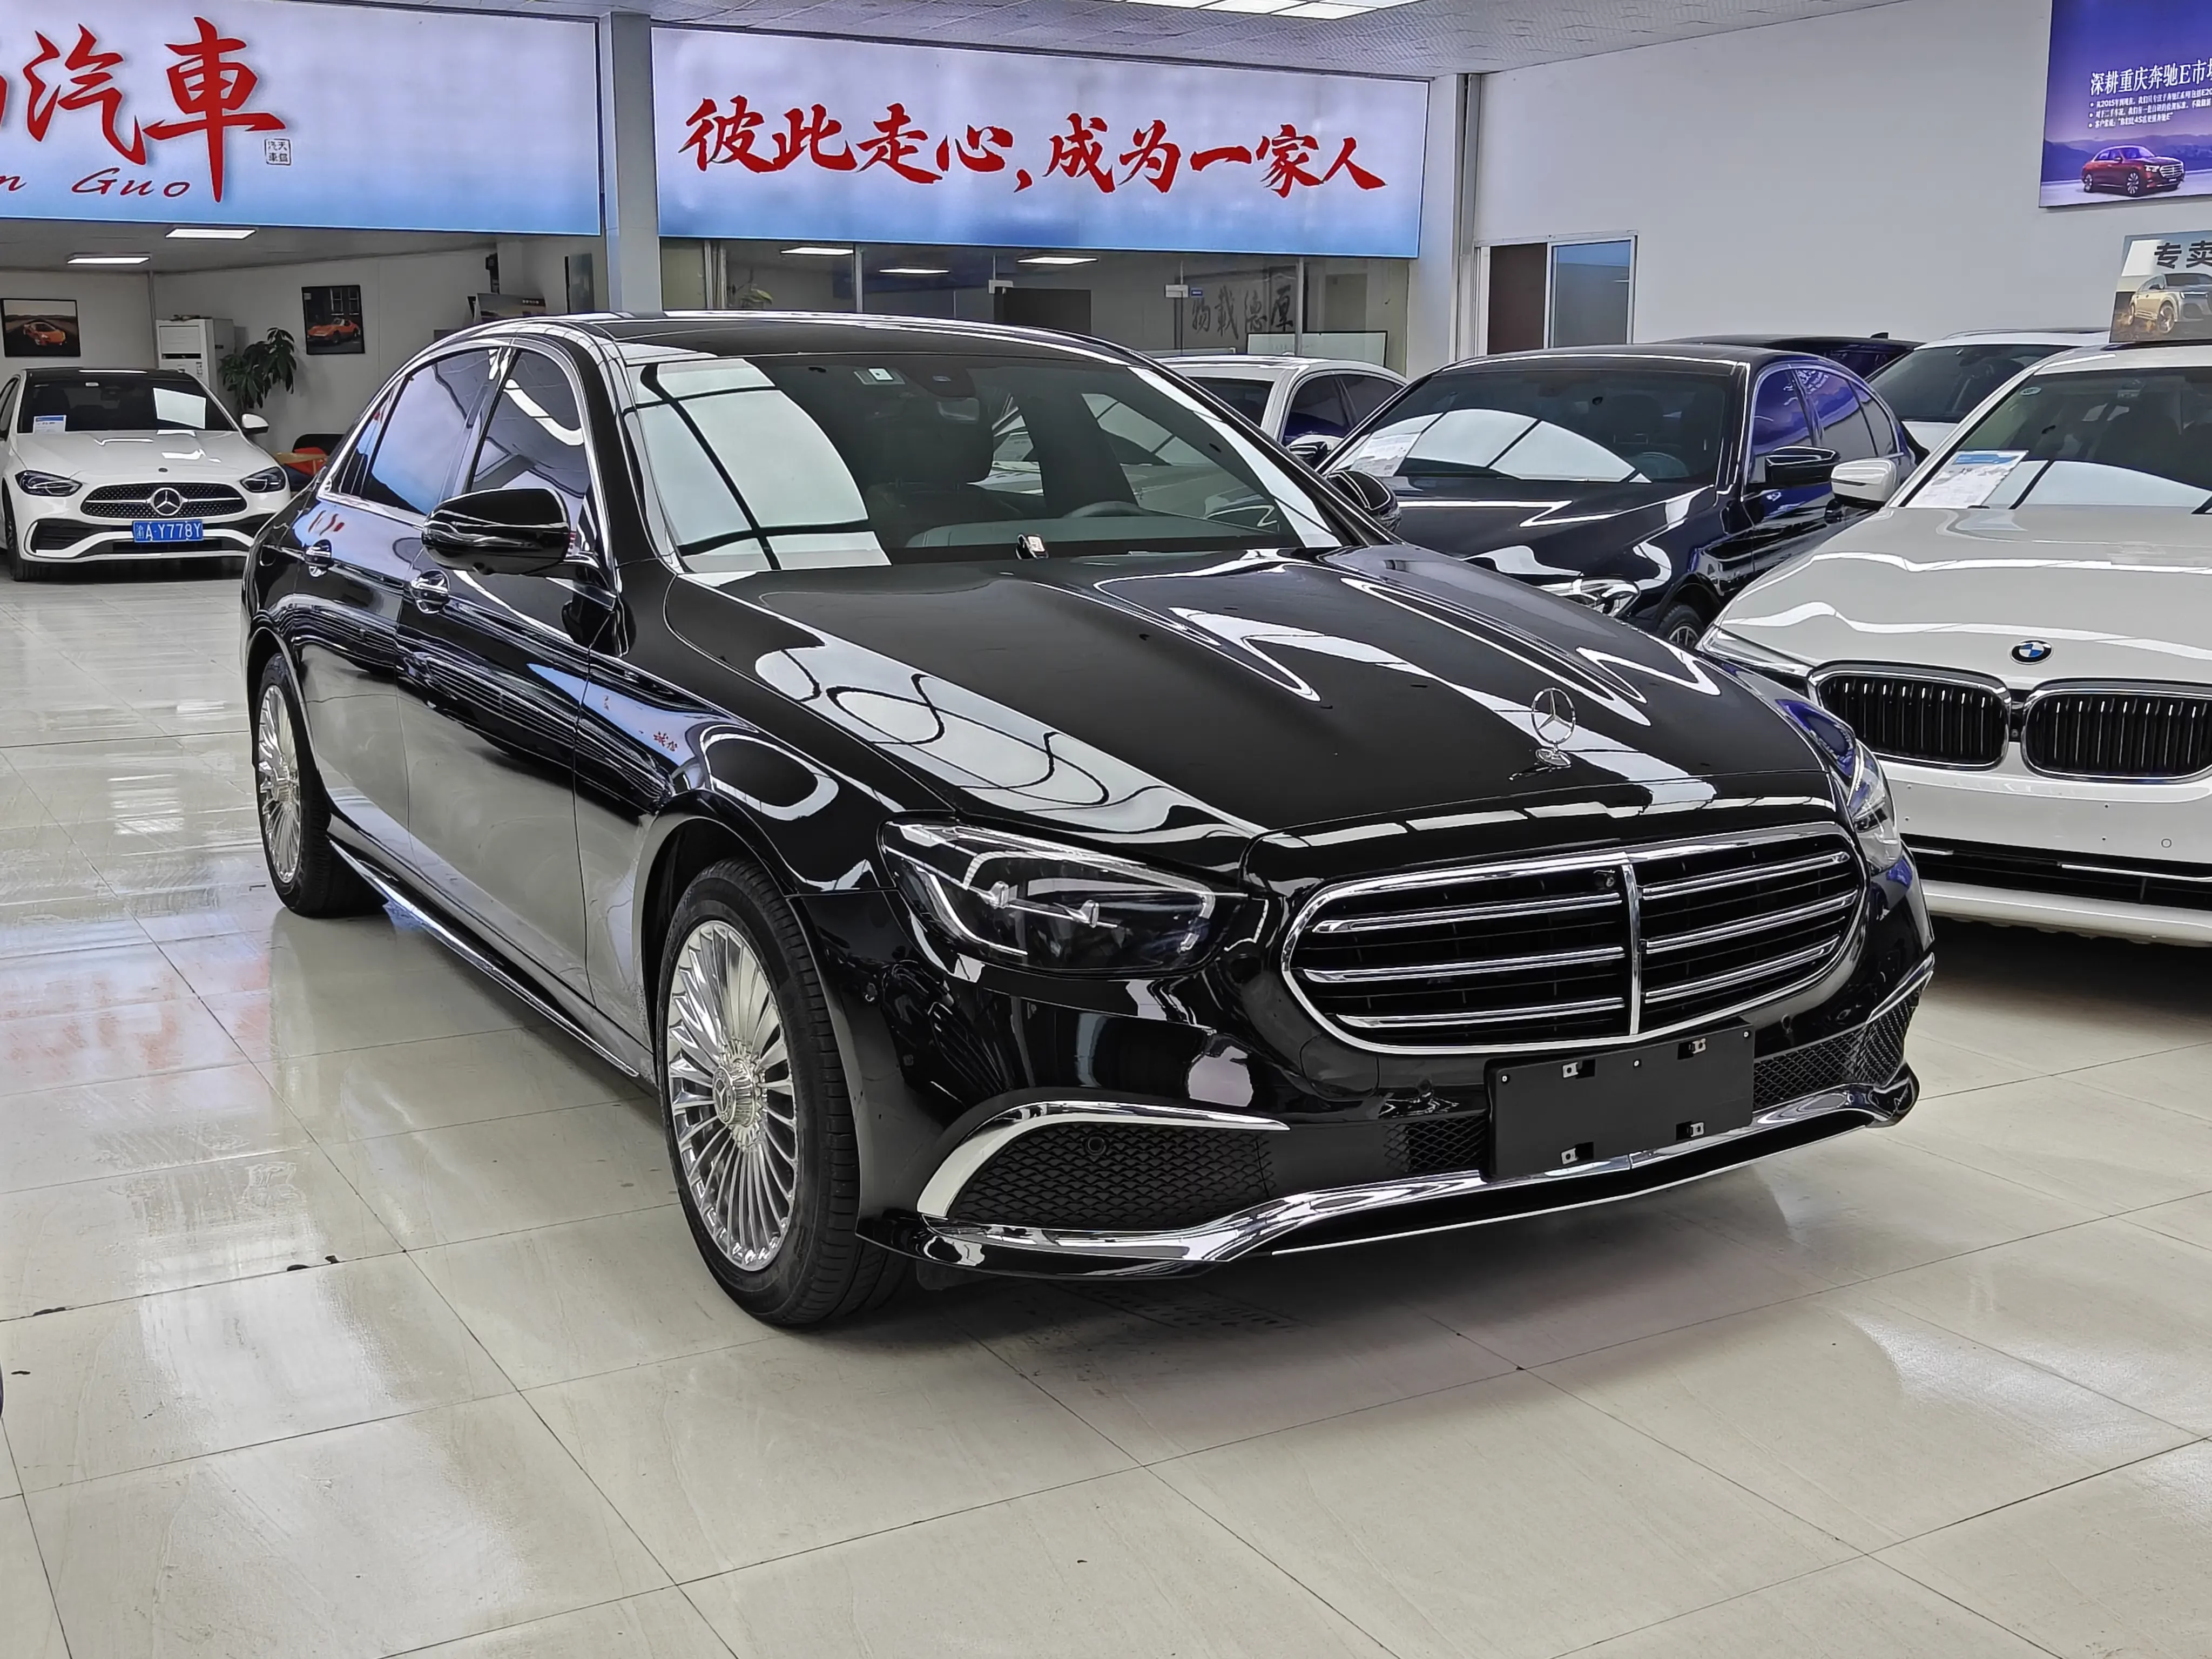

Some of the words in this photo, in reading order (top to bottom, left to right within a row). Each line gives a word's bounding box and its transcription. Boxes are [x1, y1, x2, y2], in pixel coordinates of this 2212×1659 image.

[0, 16, 286, 203] 汽車
[71, 167, 190, 197] Guo
[2154, 240, 2212, 269] 专卖
